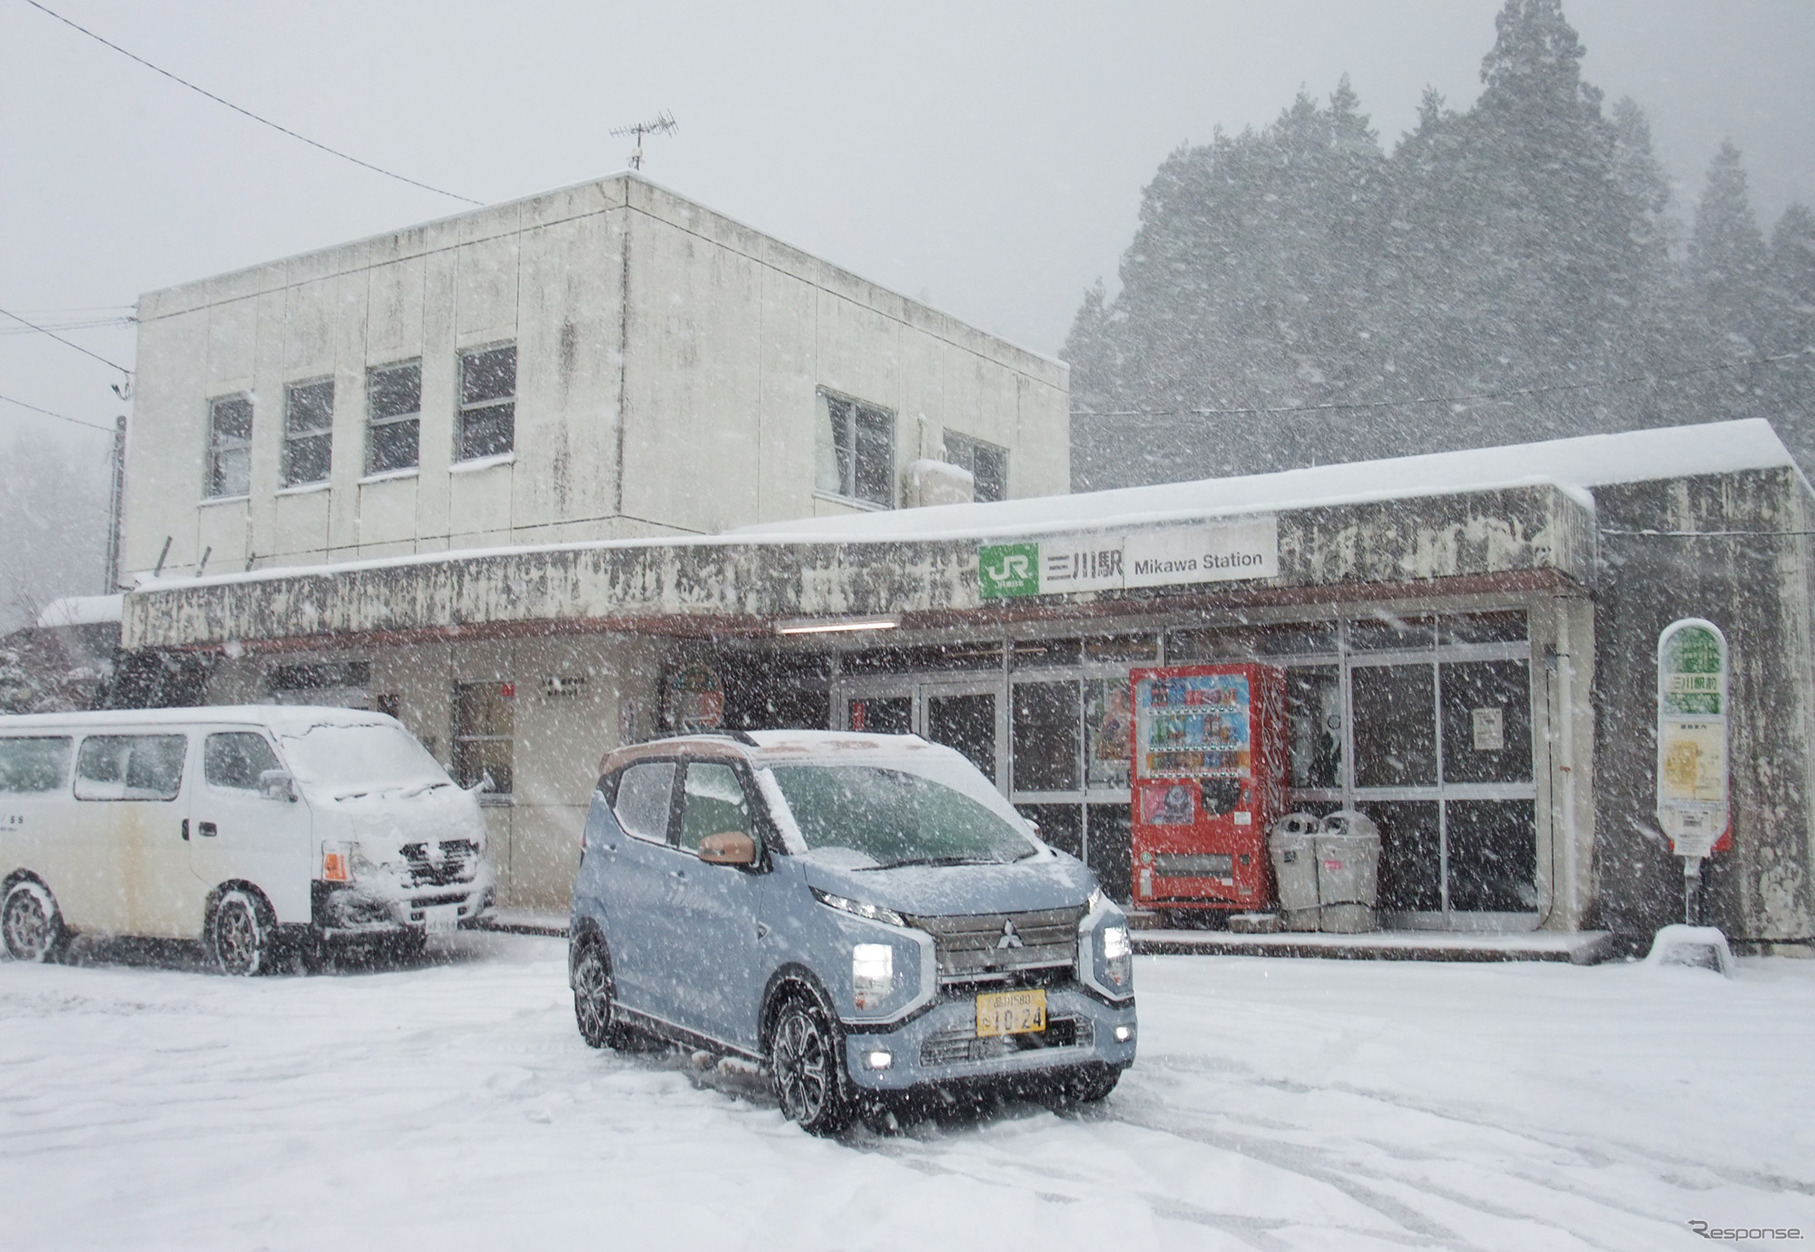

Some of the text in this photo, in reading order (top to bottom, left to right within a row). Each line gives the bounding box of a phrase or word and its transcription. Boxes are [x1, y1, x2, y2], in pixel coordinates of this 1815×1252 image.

[987, 554, 1029, 581] JR
[1046, 549, 1124, 582] 三川駅
[1134, 551, 1264, 576] Mikawa Station
